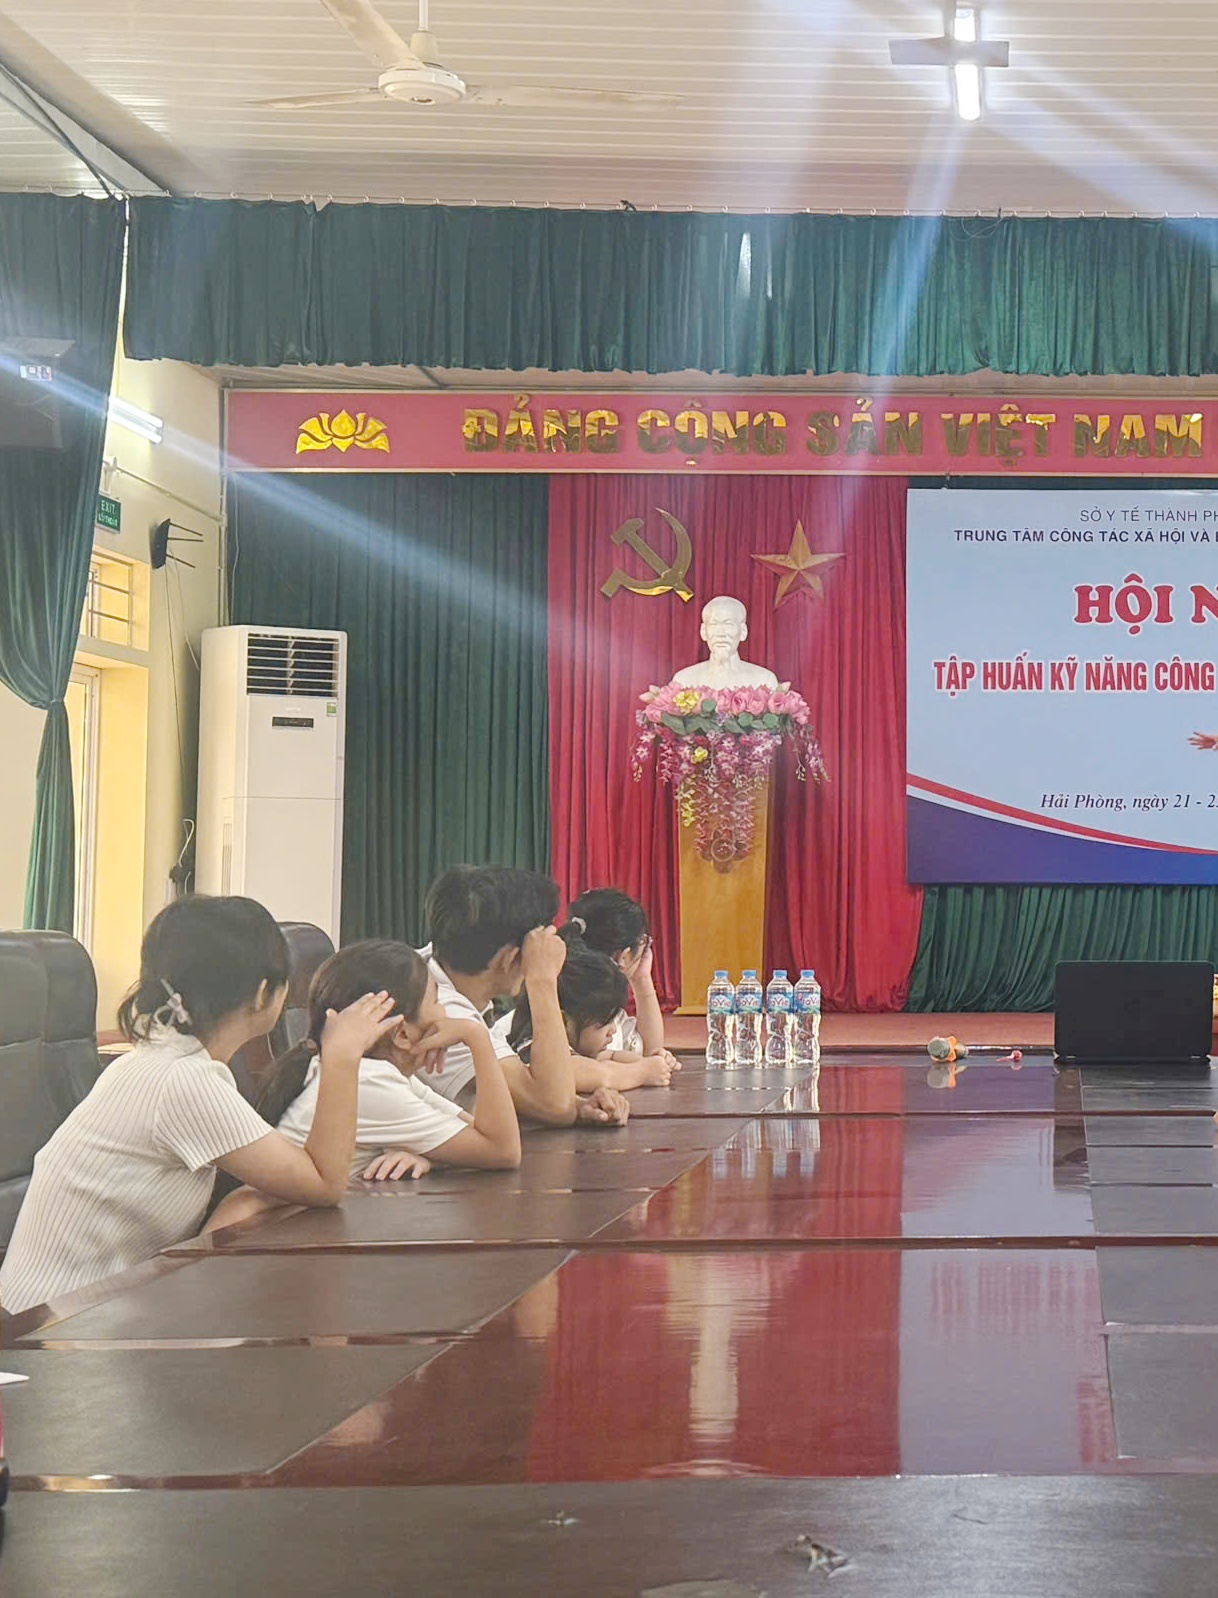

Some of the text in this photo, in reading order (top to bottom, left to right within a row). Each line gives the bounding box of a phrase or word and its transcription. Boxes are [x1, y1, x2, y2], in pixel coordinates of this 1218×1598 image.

[463, 393, 620, 453] ĐẢNG
[637, 399, 787, 465] CỘNG
[806, 397, 923, 456] SẢN
[941, 403, 1056, 466] VIỆT
[1073, 413, 1203, 458] NAM
[1080, 506, 1101, 522] SỞ
[1106, 509, 1116, 522] Y
[1121, 506, 1140, 522] TẾ
[1145, 507, 1197, 522] THÀNH
[954, 530, 1007, 542] TRUNG
[1012, 527, 1044, 542] TÂM
[1050, 528, 1094, 542] CÔNG
[1099, 527, 1129, 542] TÁC
[1134, 527, 1155, 542] XÃ
[1160, 528, 1185, 545] HỘI
[1191, 528, 1210, 542] VÀ
[1074, 573, 1174, 635] HỘI
[934, 656, 976, 696] TẬP
[983, 652, 1043, 690] HUẤN
[1051, 656, 1078, 690] KỸ
[1085, 656, 1148, 690] NĂNG
[1155, 656, 1215, 691] CÔNG
[1040, 794, 1069, 809] Hải
[1074, 794, 1127, 812] Phòng,
[1132, 794, 1168, 812] ngày
[1173, 794, 1191, 808] 21
